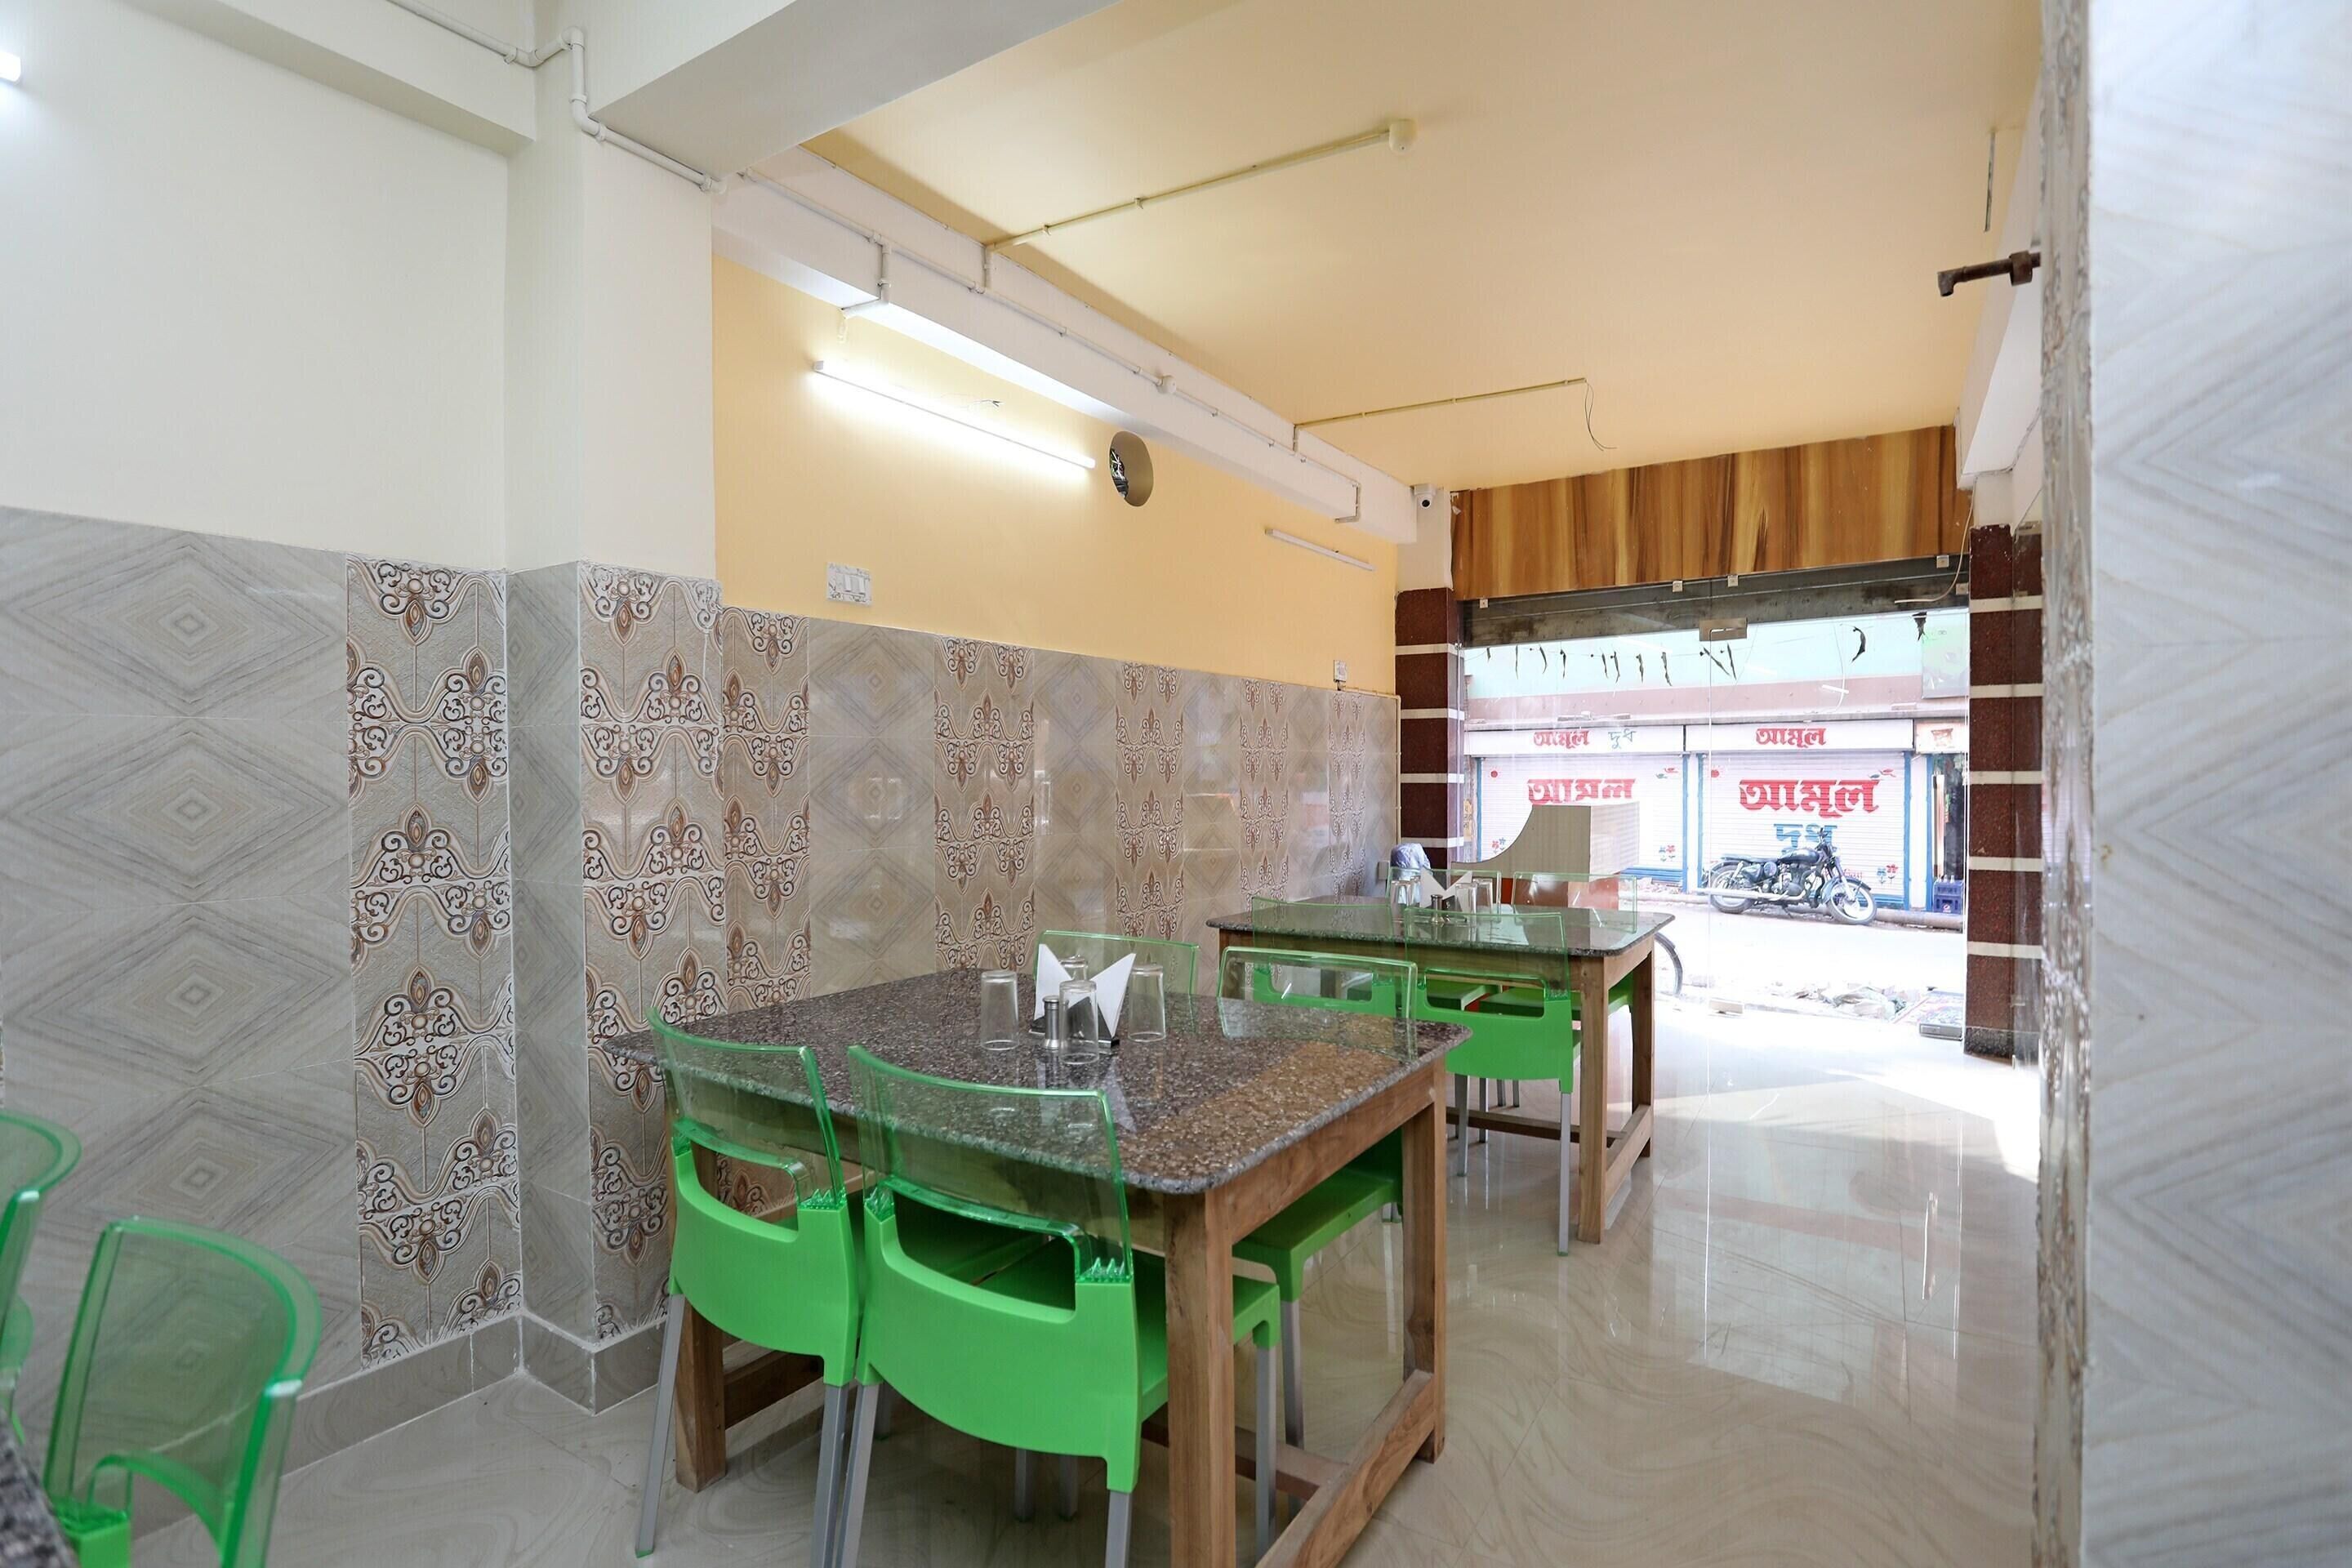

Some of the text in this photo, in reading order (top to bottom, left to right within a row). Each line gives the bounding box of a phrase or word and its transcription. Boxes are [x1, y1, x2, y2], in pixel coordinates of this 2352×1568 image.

[1533, 728, 1636, 749] আমূল দুধ
[1756, 728, 1826, 748] আমূল
[1527, 778, 1636, 804] আমল
[1740, 779, 1881, 817] আমূল
